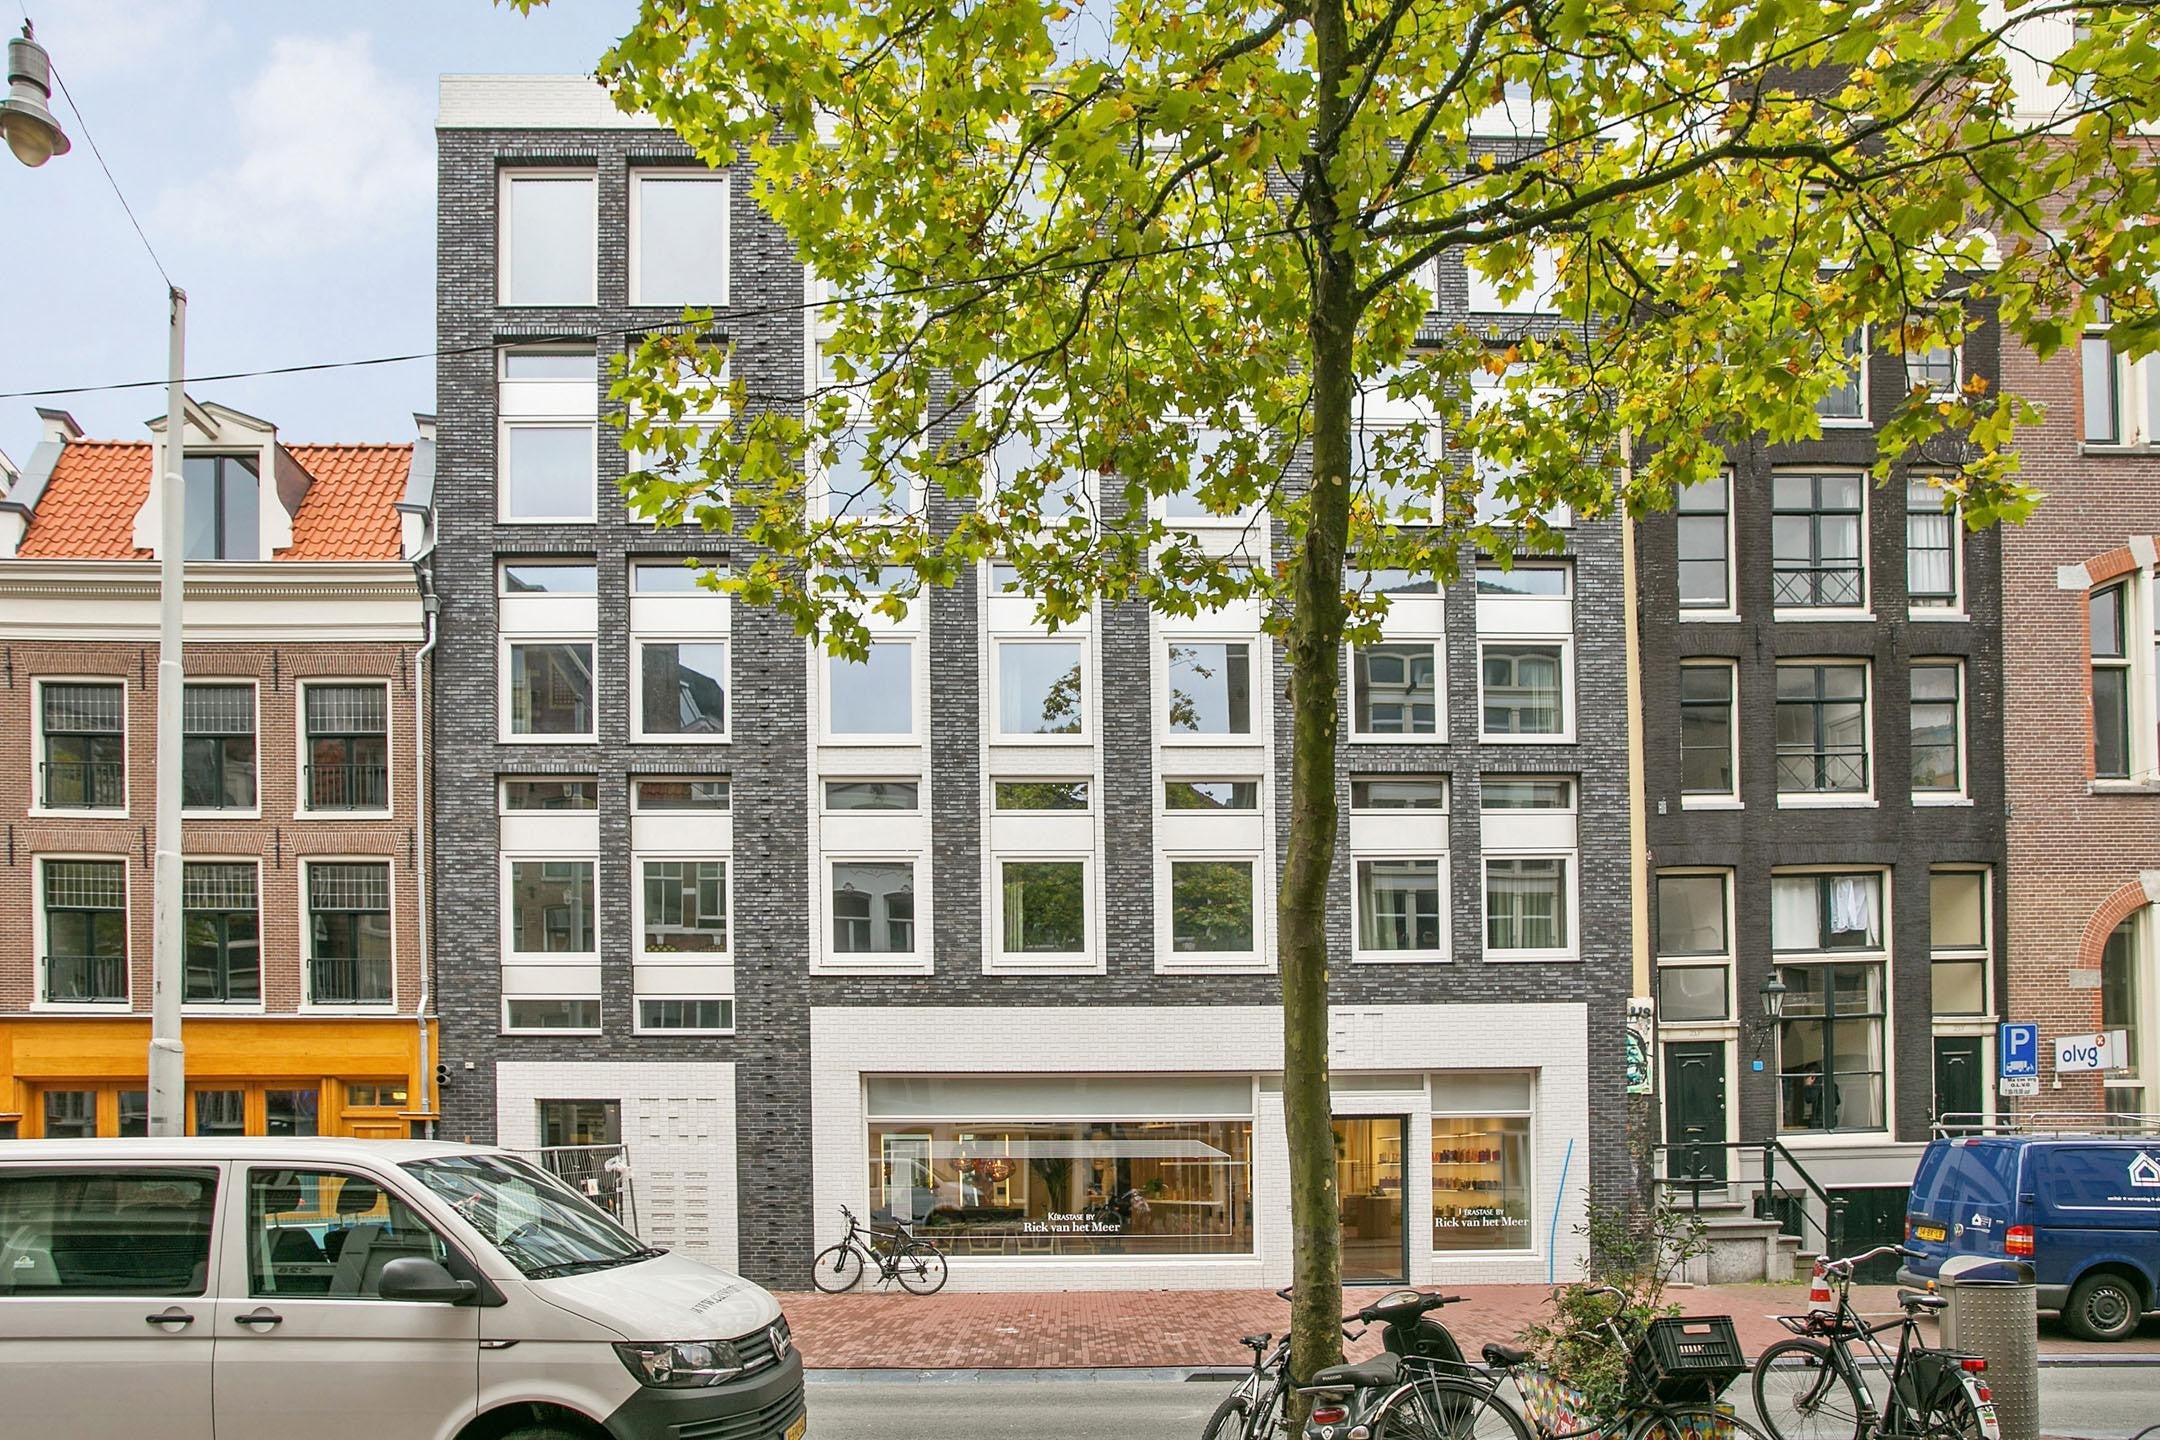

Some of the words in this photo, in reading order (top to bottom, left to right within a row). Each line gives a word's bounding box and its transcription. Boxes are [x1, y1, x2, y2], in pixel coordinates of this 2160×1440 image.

[2010, 1028, 2030, 1055] P
[2062, 1044, 2098, 1067] olvg
[1023, 1222, 1048, 1232] Rick
[1051, 1224, 1070, 1232] van
[1072, 1222, 1089, 1232] het
[1092, 1222, 1120, 1232] Meer
[1435, 1217, 1459, 1228] Rick
[1461, 1219, 1480, 1227] van
[1482, 1216, 1499, 1227] het
[1501, 1217, 1529, 1227] Meer
